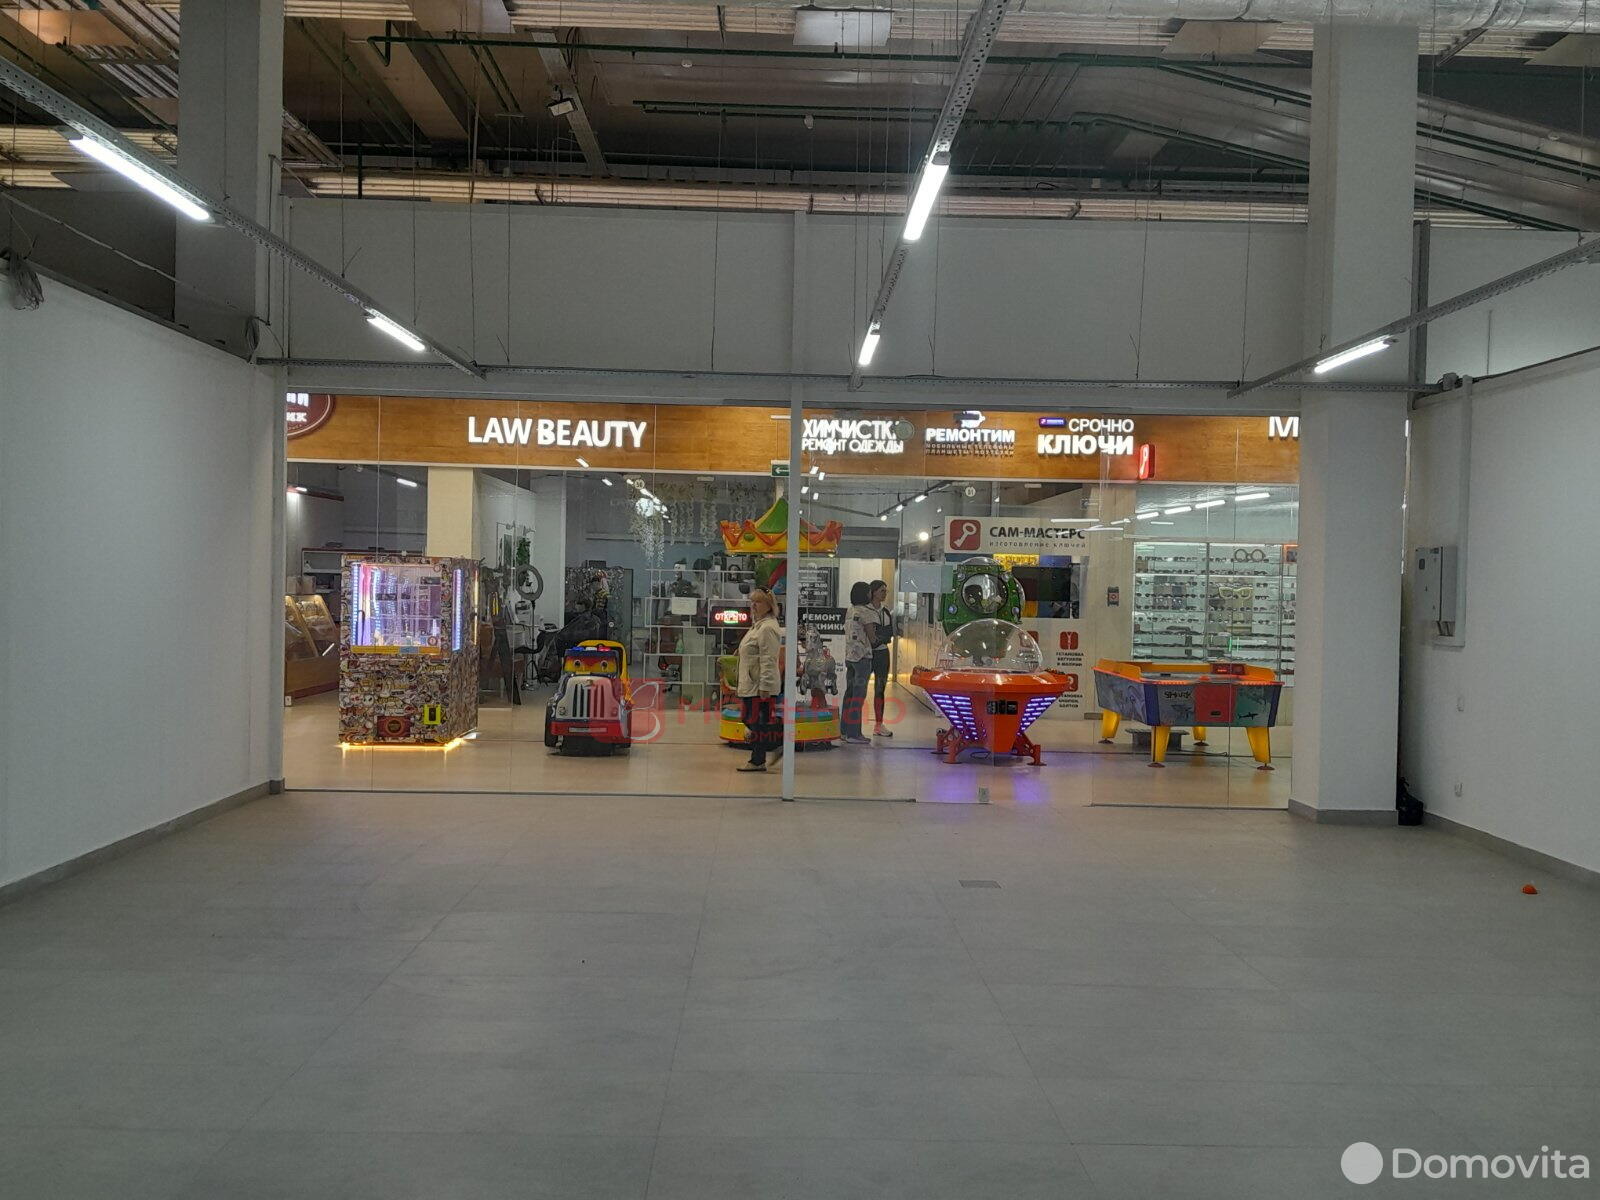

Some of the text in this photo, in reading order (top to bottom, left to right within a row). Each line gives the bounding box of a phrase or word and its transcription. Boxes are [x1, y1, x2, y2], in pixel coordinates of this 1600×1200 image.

[468, 416, 647, 448] LAW BEAUTY
[1068, 418, 1134, 433] СРОЧНО
[925, 428, 1016, 443] РЕМОНТИМ
[801, 438, 904, 454] РЕМОНТ ОДЕЖДЫ
[1037, 434, 1134, 455] КЛЮЧИ
[989, 526, 1086, 540] САМ-МАСТЕРС
[802, 613, 842, 621] РЕМОНТ
